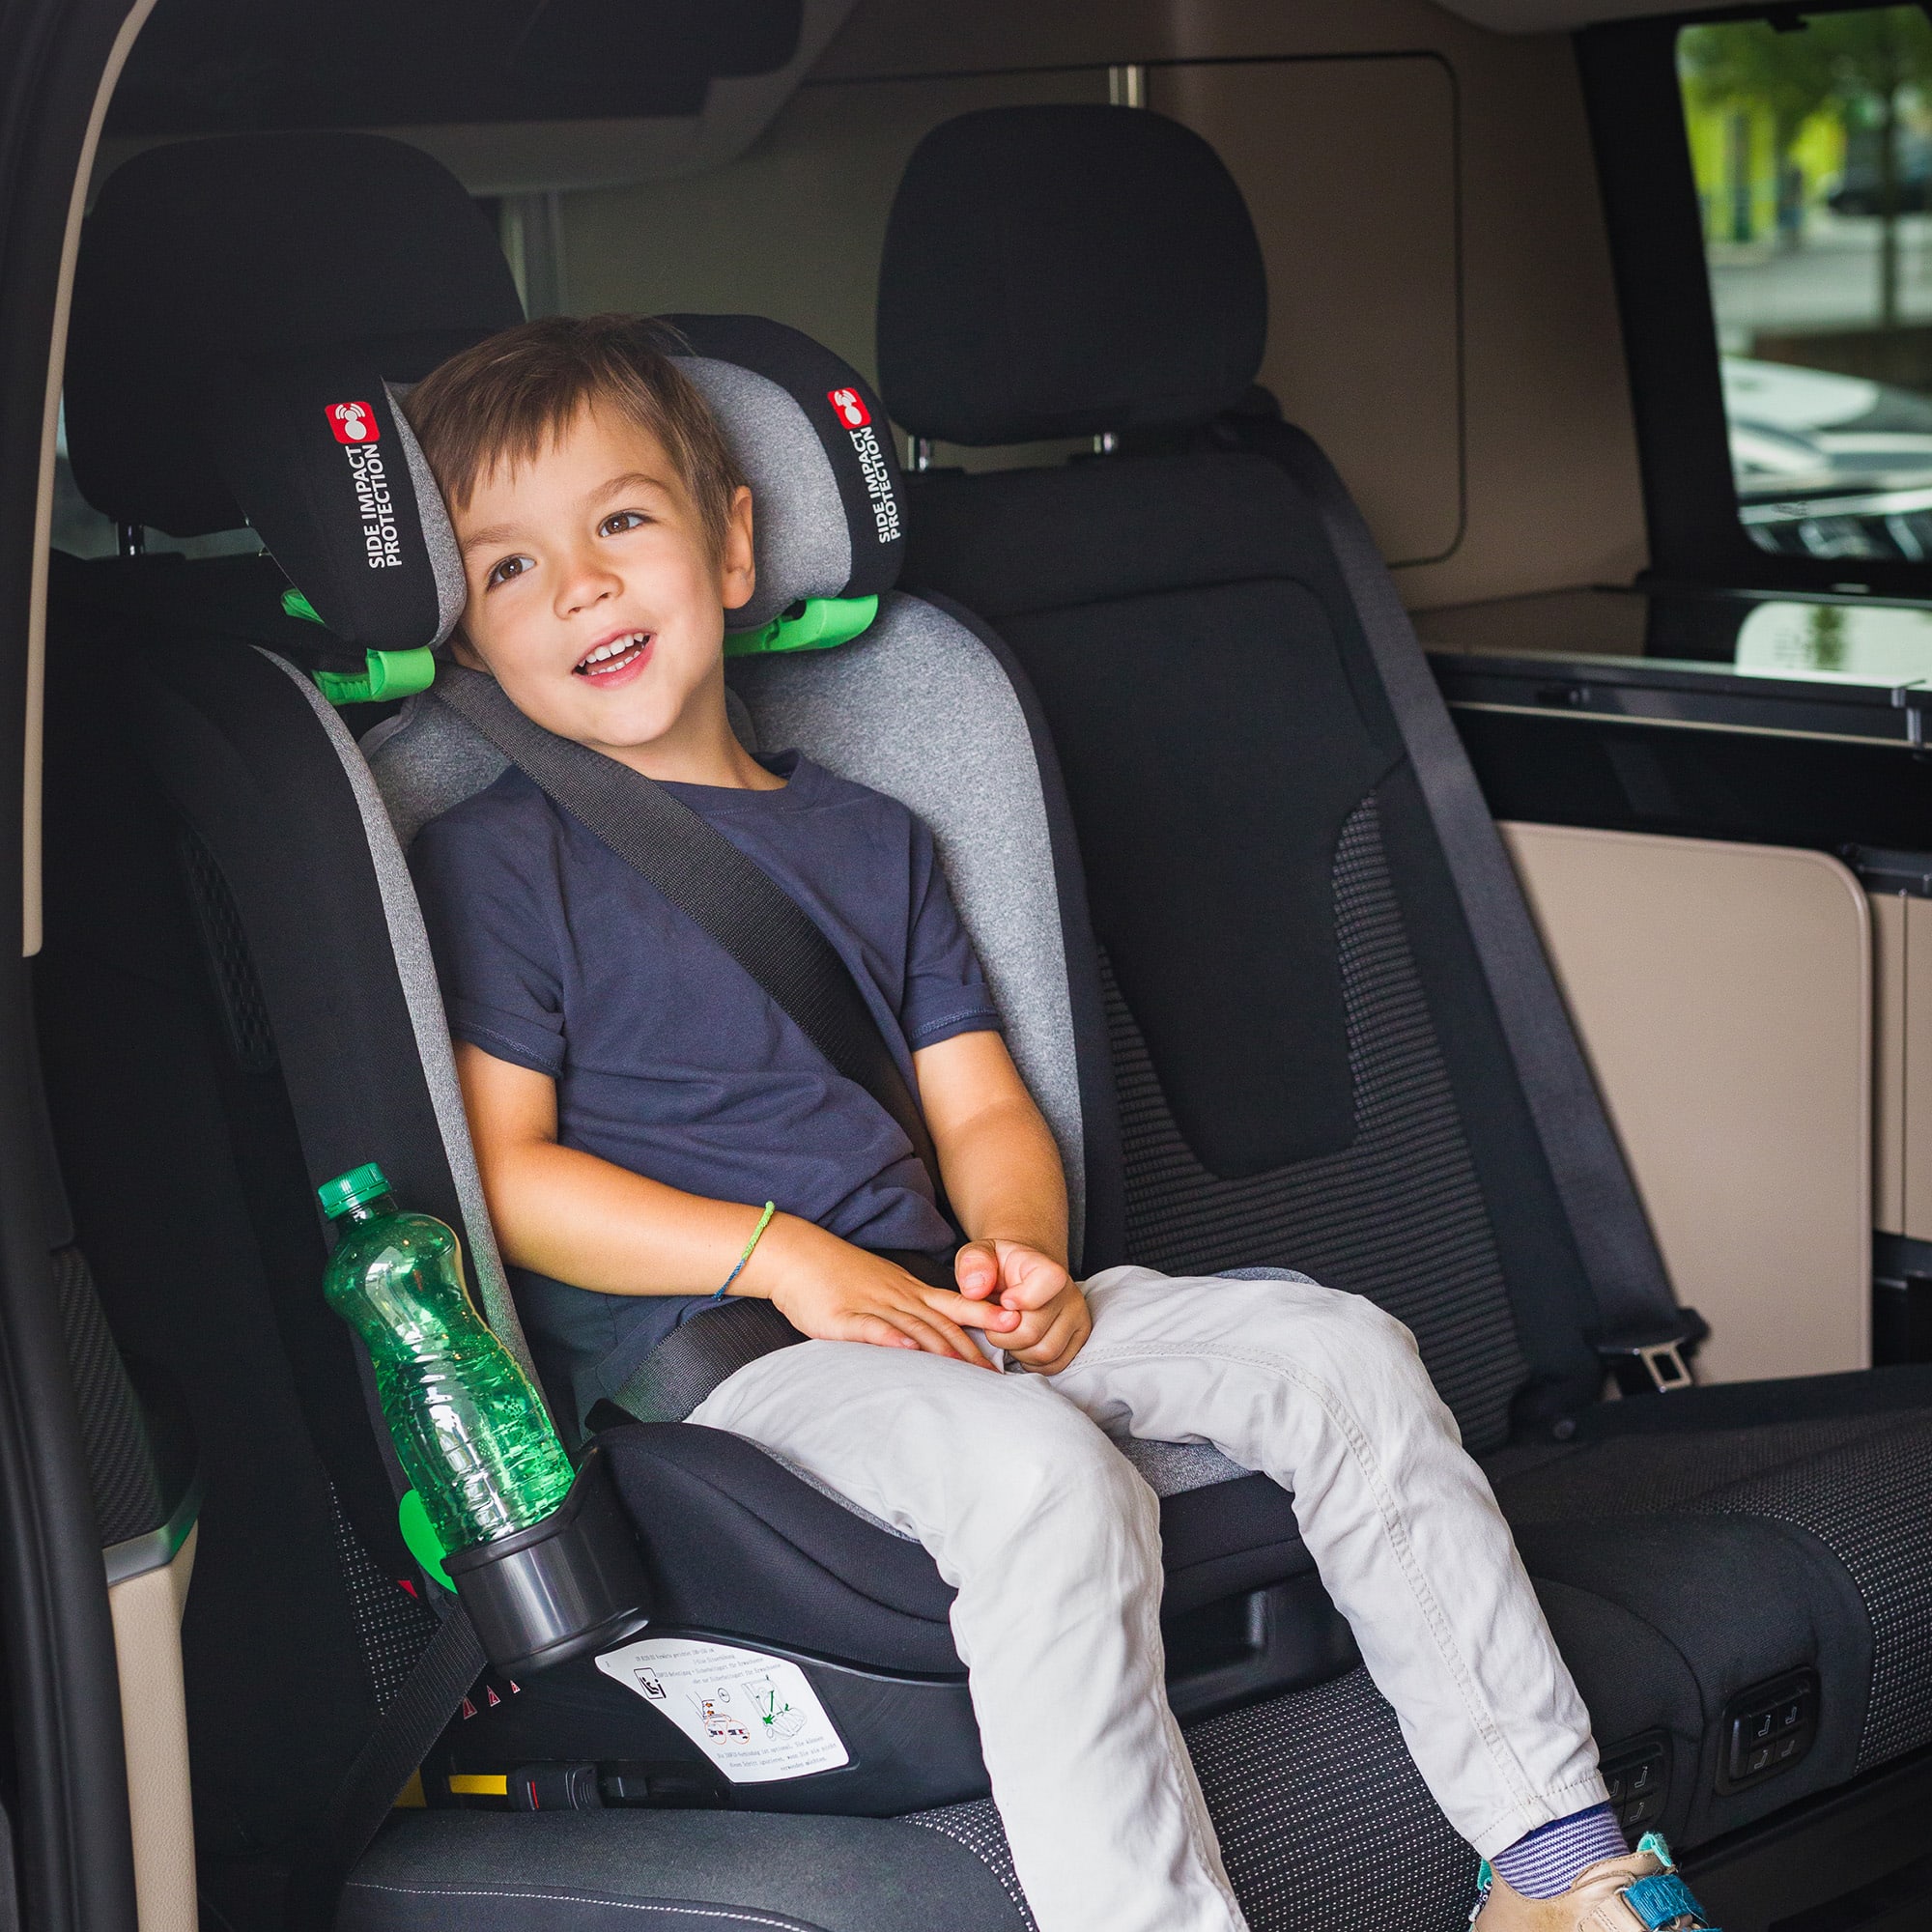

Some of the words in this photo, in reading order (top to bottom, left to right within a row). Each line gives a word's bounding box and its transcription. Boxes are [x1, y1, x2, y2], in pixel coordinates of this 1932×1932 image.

[345, 445, 378, 520] IMPACT
[849, 430, 881, 499] IMPACT
[861, 426, 901, 541] PROTECTION
[362, 443, 403, 567] PROTECTION
[873, 502, 891, 544] SIDE
[364, 525, 385, 569] SIDE
